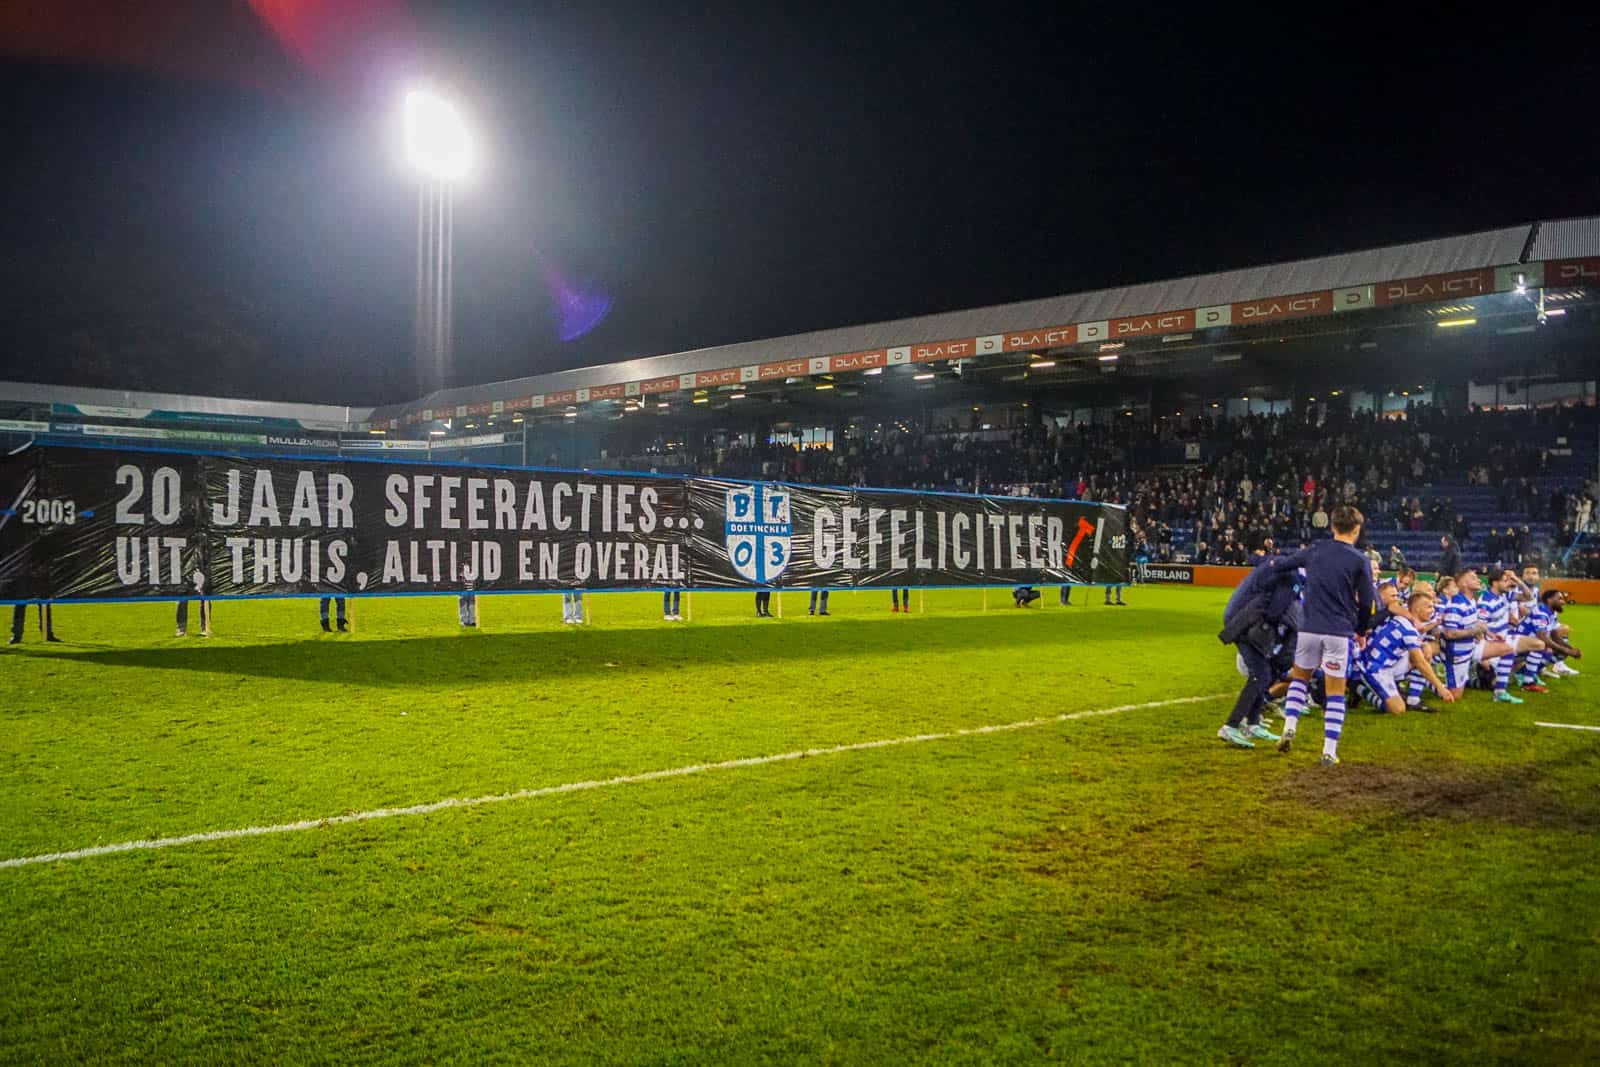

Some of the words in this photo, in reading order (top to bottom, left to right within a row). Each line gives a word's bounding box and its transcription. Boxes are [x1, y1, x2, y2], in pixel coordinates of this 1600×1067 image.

[1560, 265, 1598, 278] DL
[1388, 284, 1434, 299] DLA
[1442, 277, 1480, 292] ICT
[1242, 303, 1281, 318] DLA
[1288, 298, 1321, 312] ICT
[1118, 321, 1152, 333] DLA
[1158, 315, 1185, 328] ICT
[1010, 335, 1040, 346] DLA
[1044, 331, 1069, 344] ICT
[917, 347, 943, 358] DLA
[947, 343, 969, 354] ICT
[835, 358, 859, 368] DLA
[862, 354, 880, 364] ICT
[115, 464, 182, 526] 20
[212, 469, 354, 528] JAAR
[384, 474, 704, 534] SFEERACTIES...
[21, 500, 77, 526] 2003
[115, 536, 206, 593] UIT,
[225, 537, 369, 590] THUIS,
[382, 540, 501, 584] ALTIJD
[518, 540, 560, 580] EN
[575, 541, 685, 581] OVERAL
[1133, 566, 1191, 580] DERLAND
